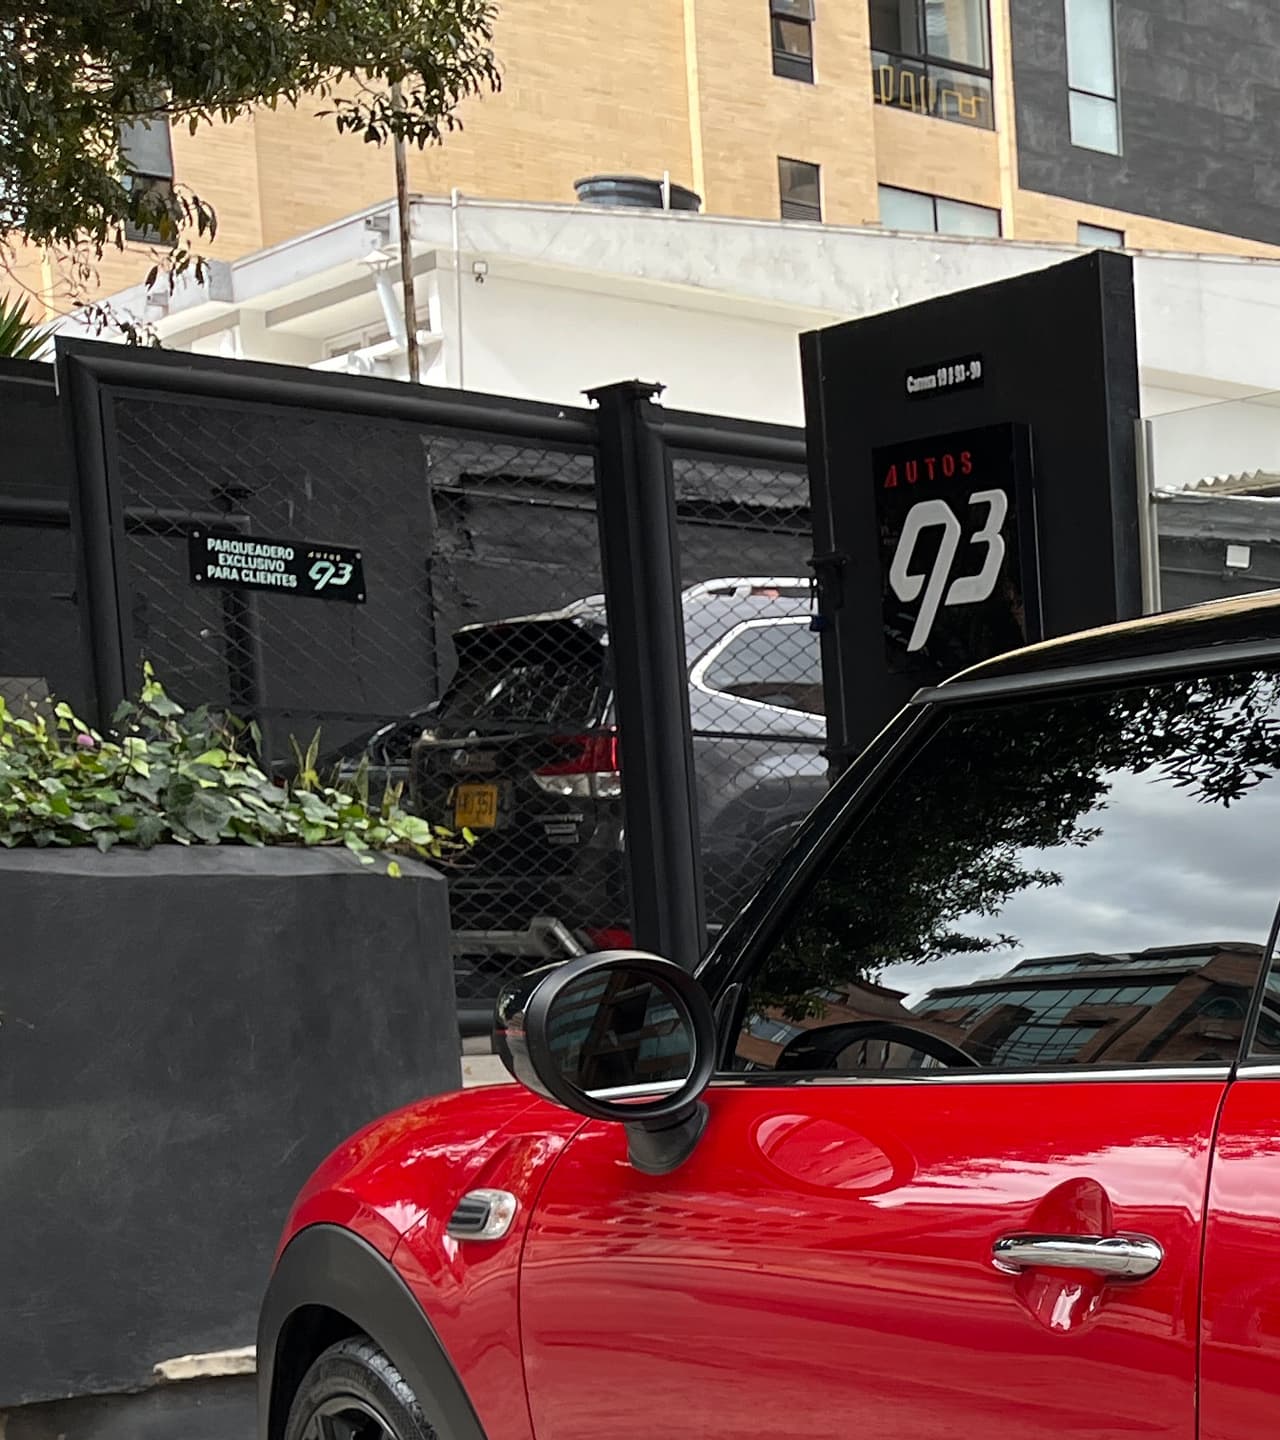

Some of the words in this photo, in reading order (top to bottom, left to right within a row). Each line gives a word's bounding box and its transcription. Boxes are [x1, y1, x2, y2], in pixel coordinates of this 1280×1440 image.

[884, 451, 973, 488] AUTOS
[207, 538, 295, 561] PARQUEADERO
[307, 551, 341, 562] AUTOS
[218, 553, 285, 572] EXCLUSIVO
[889, 488, 1008, 652] 93
[207, 564, 239, 581] PARA
[241, 570, 297, 588] CLIENTES
[308, 561, 353, 590] 93
